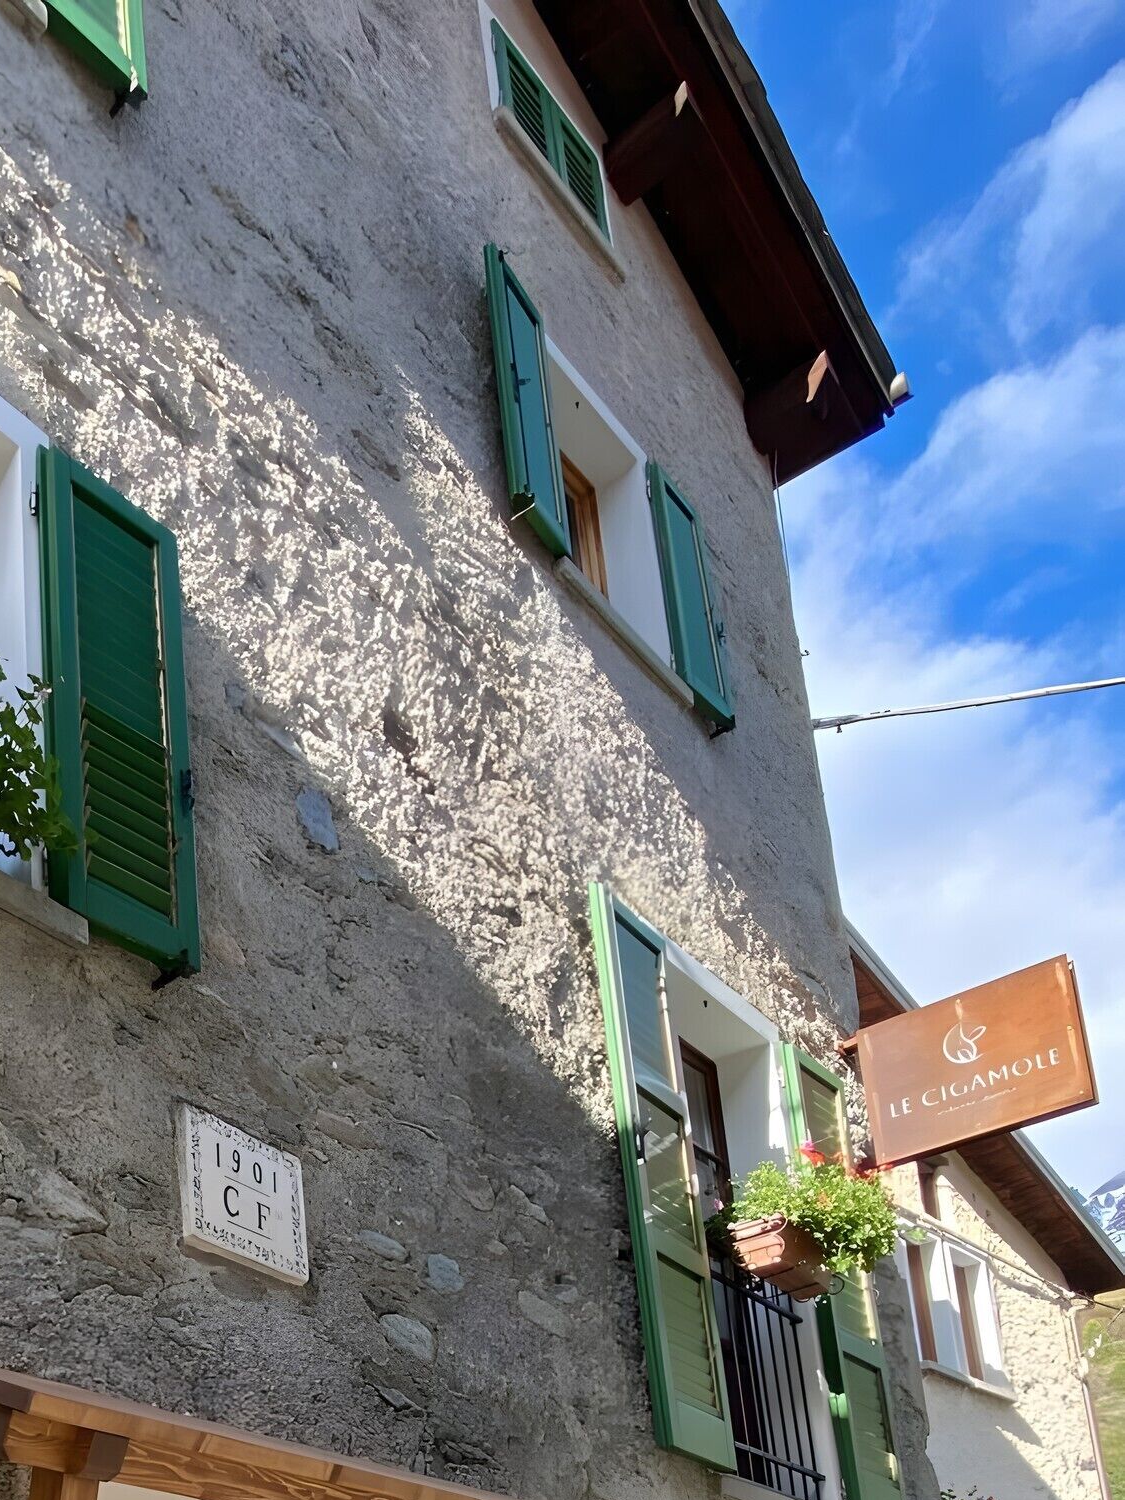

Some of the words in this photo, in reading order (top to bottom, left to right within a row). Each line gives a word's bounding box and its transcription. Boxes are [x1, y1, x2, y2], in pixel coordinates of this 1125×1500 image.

[890, 1097, 913, 1119] LE
[921, 1047, 1060, 1107] CIGAMOLE
[216, 1142, 277, 1194] 1901
